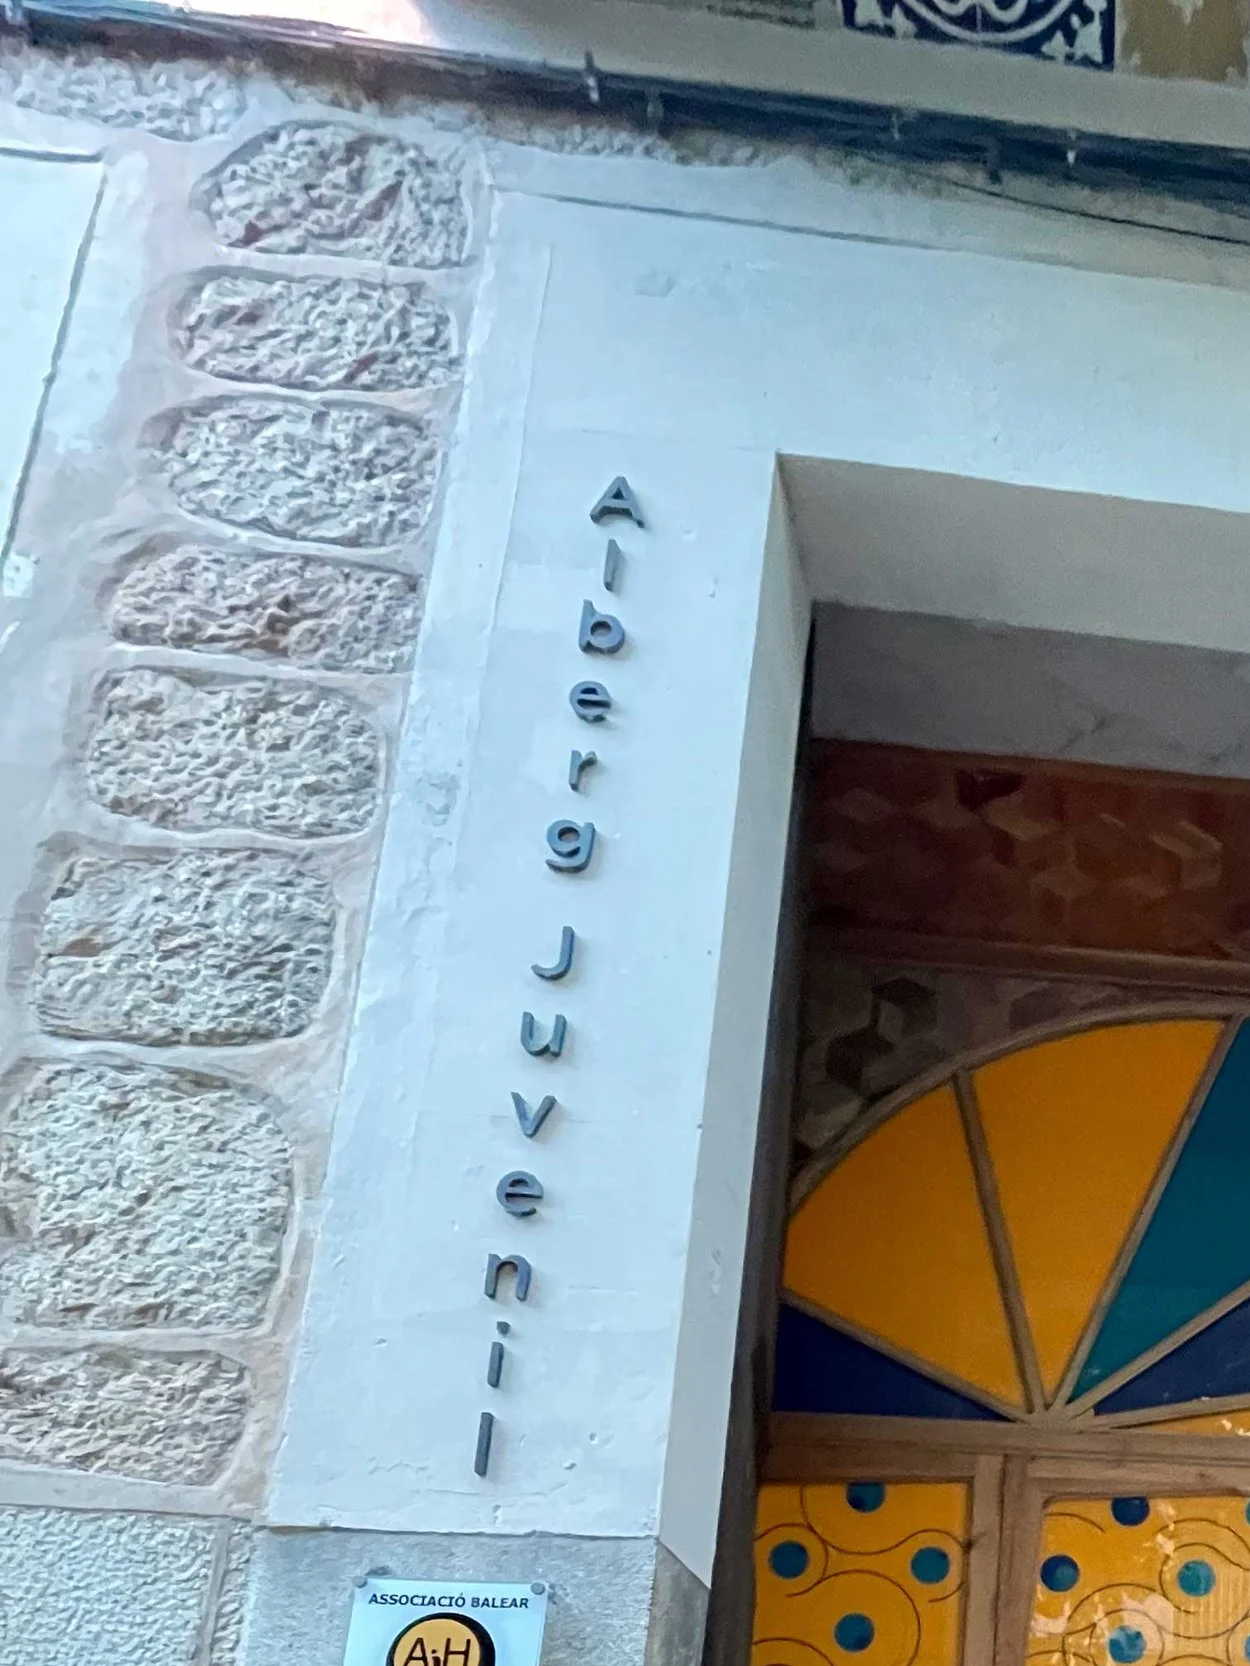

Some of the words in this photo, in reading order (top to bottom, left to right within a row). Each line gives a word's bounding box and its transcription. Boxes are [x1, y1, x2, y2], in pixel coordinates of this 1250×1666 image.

[546, 476, 645, 873] Alberg
[474, 925, 575, 1477] Juvenil
[368, 1592, 466, 1608] ASSOCIACIÓ
[471, 1597, 529, 1609] BALEAR
